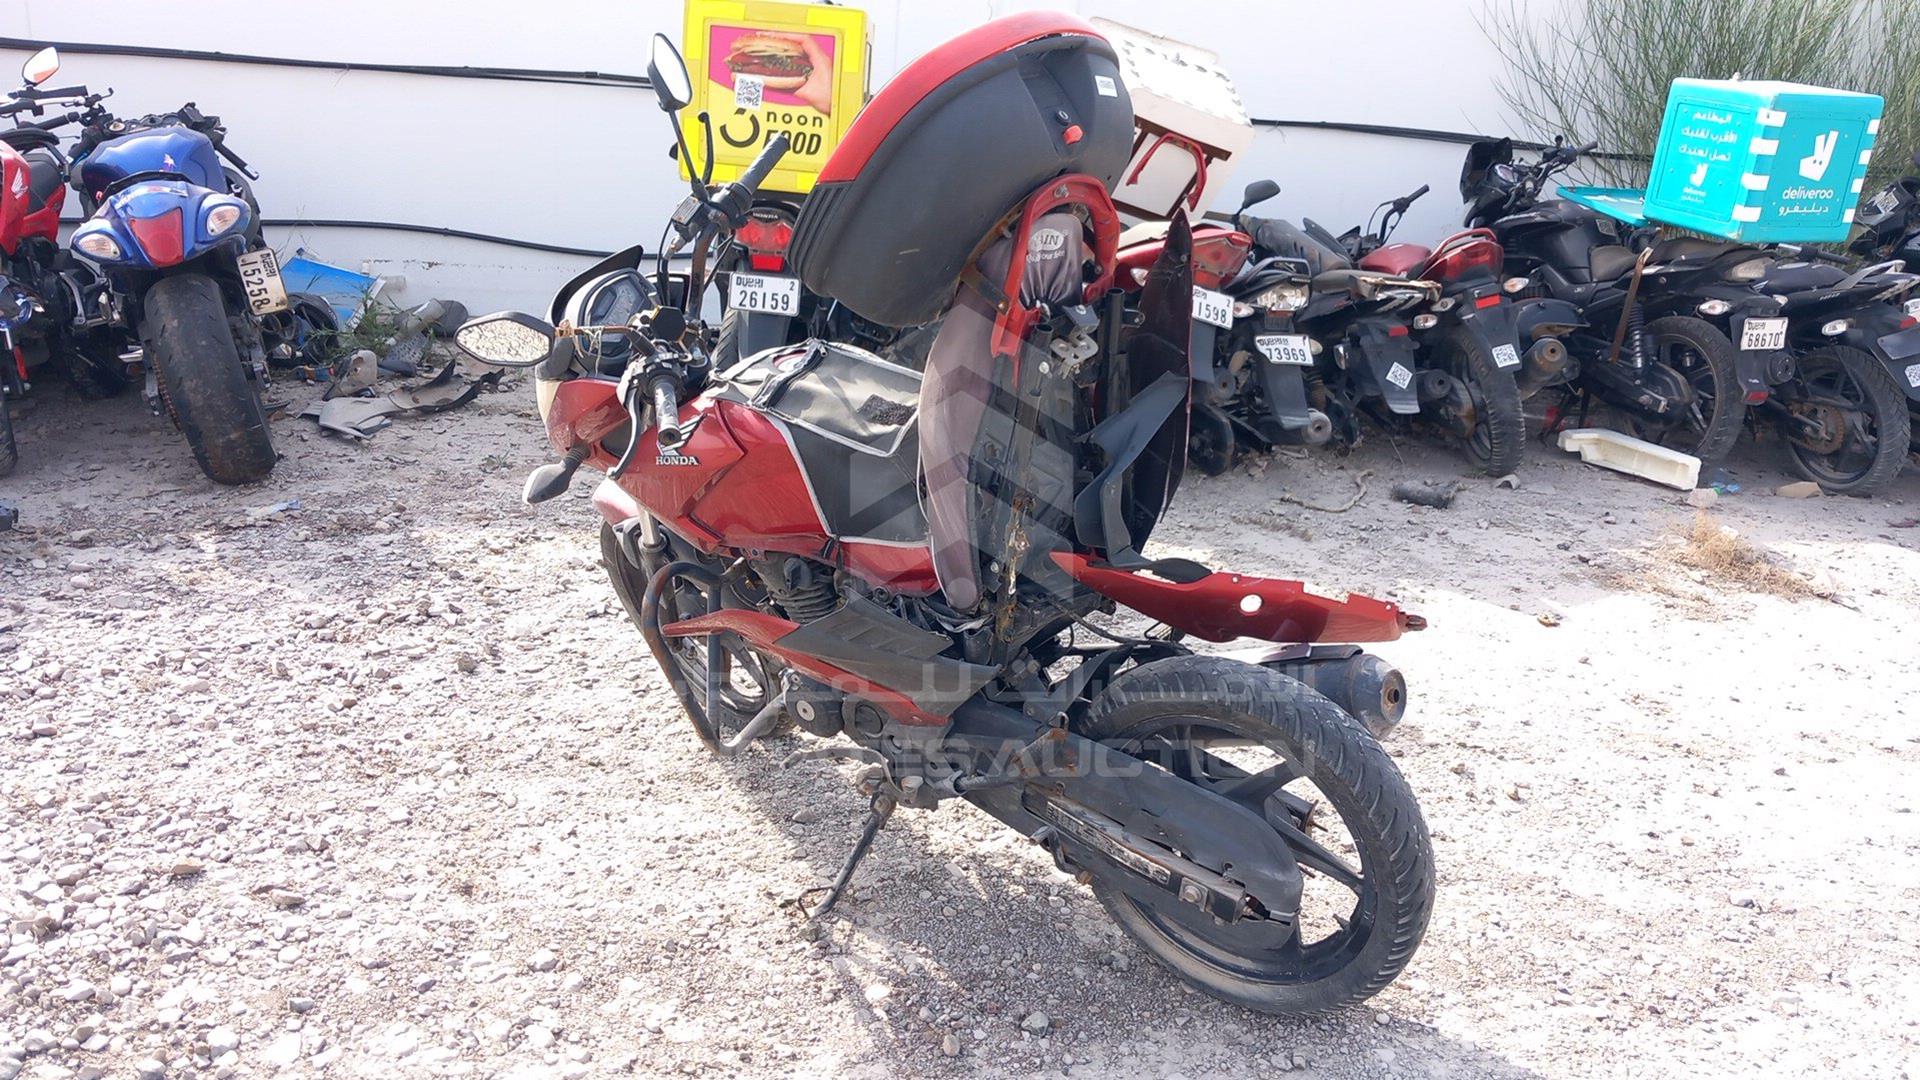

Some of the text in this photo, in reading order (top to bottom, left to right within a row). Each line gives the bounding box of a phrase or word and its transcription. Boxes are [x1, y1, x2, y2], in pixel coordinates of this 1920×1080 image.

[766, 111, 823, 128] noon
[1783, 187, 1834, 200] deliveroo
[1779, 202, 1829, 217] ديليفرو
[240, 261, 271, 310] 15258
[789, 281, 796, 291] 2
[738, 290, 790, 312] 26159
[1747, 332, 1780, 348] 68670
[1265, 347, 1307, 362] 73969
[655, 456, 699, 466] HONDA
